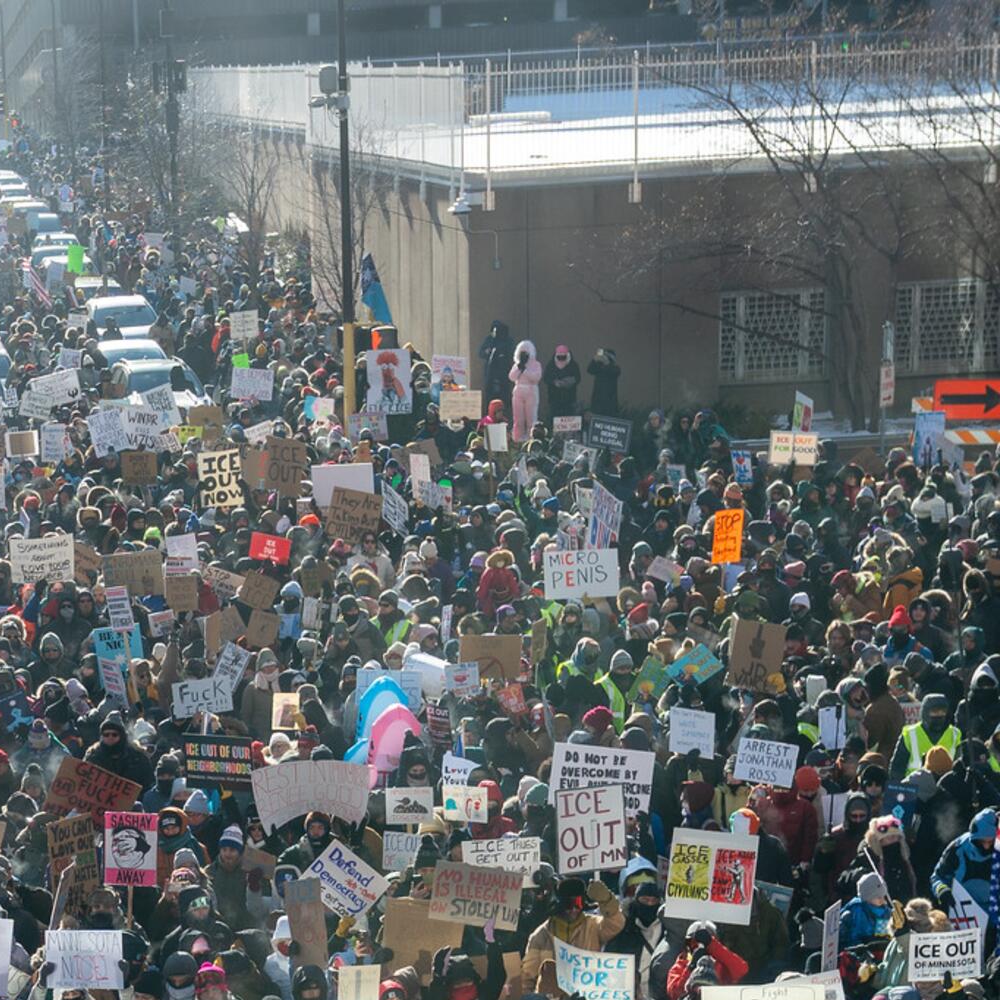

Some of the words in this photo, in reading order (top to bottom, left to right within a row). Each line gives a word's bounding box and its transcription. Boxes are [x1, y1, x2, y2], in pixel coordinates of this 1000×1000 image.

[203, 452, 240, 474] ICE
[203, 472, 241, 491] OUT
[203, 489, 243, 506] NOW
[549, 550, 599, 567] MICRO
[551, 568, 609, 590] PENIS
[745, 742, 790, 755] ARREST
[739, 755, 792, 770] JONATHAN
[749, 768, 777, 781] ROSS
[560, 790, 610, 818] ICE
[560, 821, 621, 851] OUT
[568, 855, 588, 869] OF
[601, 848, 626, 863] MN
[914, 945, 941, 958] ICE
[945, 940, 976, 957] OUT
[914, 961, 927, 969] OF
[928, 958, 976, 968] MINNESOTA
